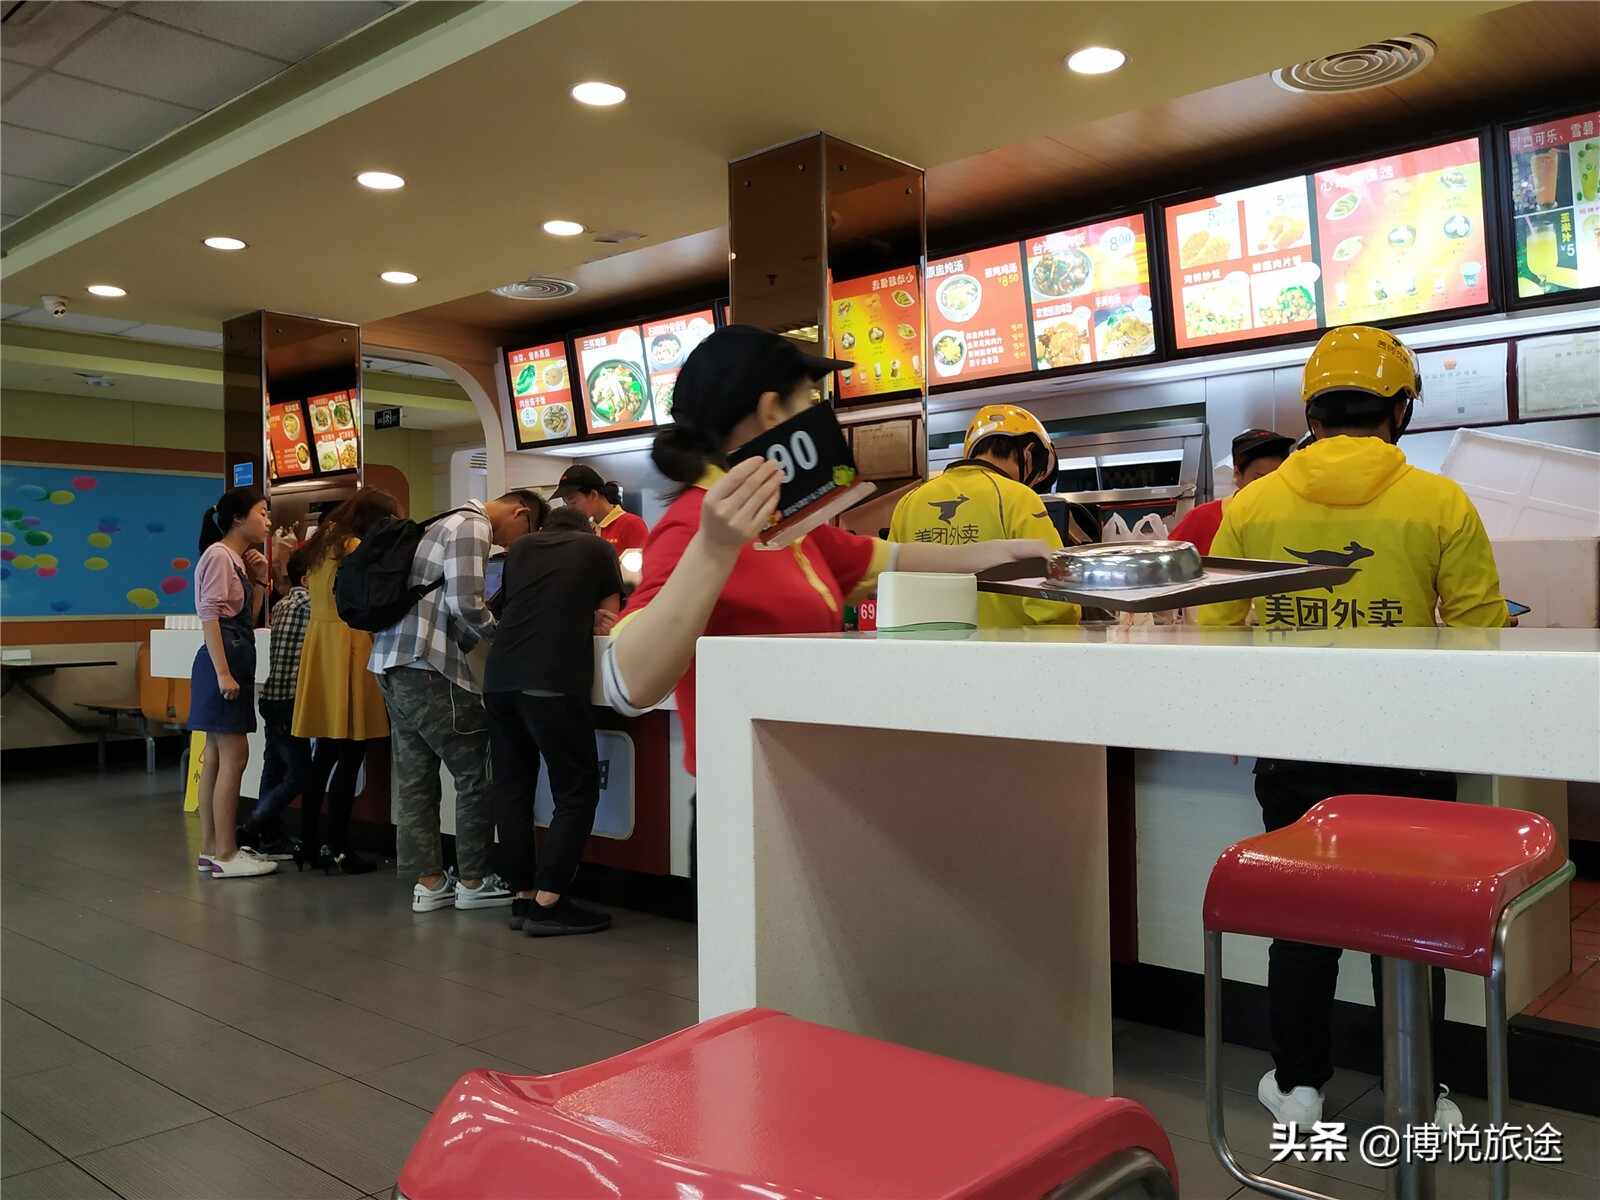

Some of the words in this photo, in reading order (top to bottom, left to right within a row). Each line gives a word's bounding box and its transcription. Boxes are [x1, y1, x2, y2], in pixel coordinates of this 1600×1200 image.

[766, 430, 819, 484] 90
[915, 523, 980, 546] 美团外卖
[861, 603, 876, 620] 69
[1265, 594, 1404, 628] 美团外卖
